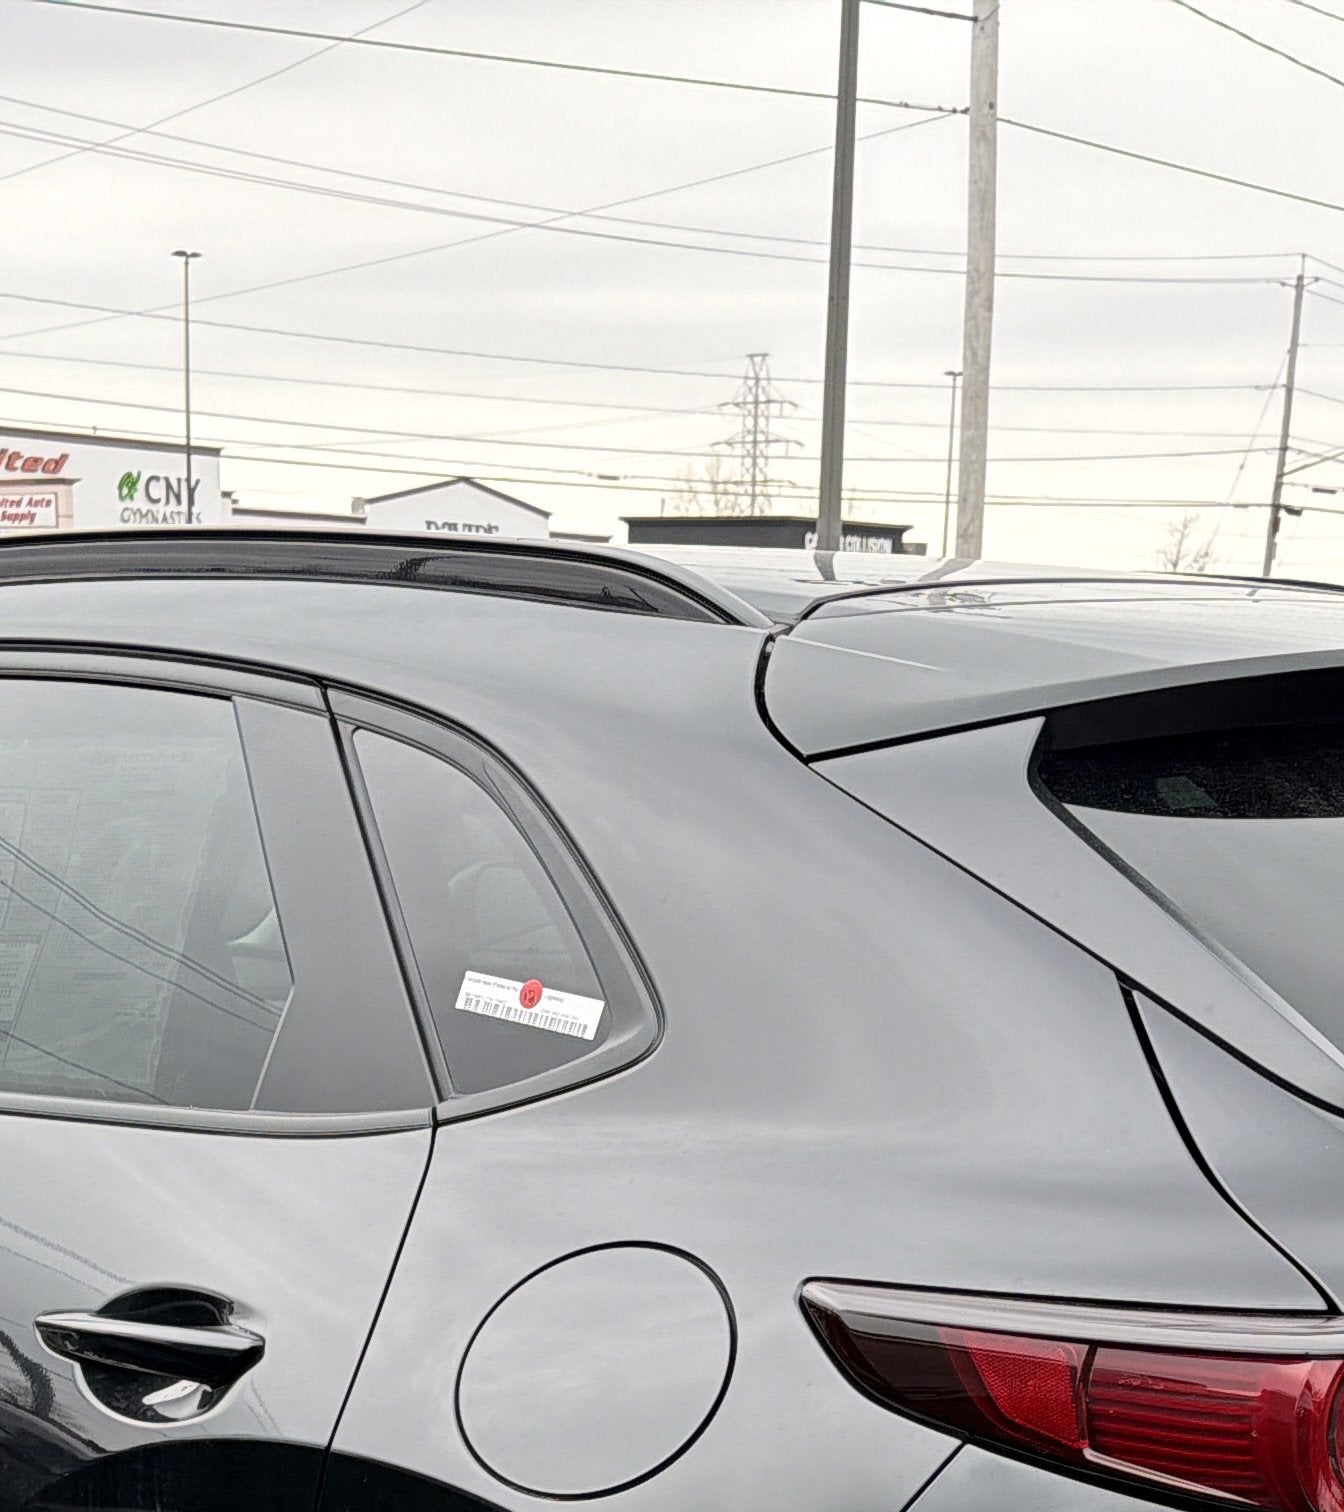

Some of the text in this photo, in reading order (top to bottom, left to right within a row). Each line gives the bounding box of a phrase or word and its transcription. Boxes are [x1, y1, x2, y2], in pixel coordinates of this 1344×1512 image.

[145, 475, 201, 506] CNY
[25, 497, 53, 508] Auto
[0, 510, 37, 525] Supply
